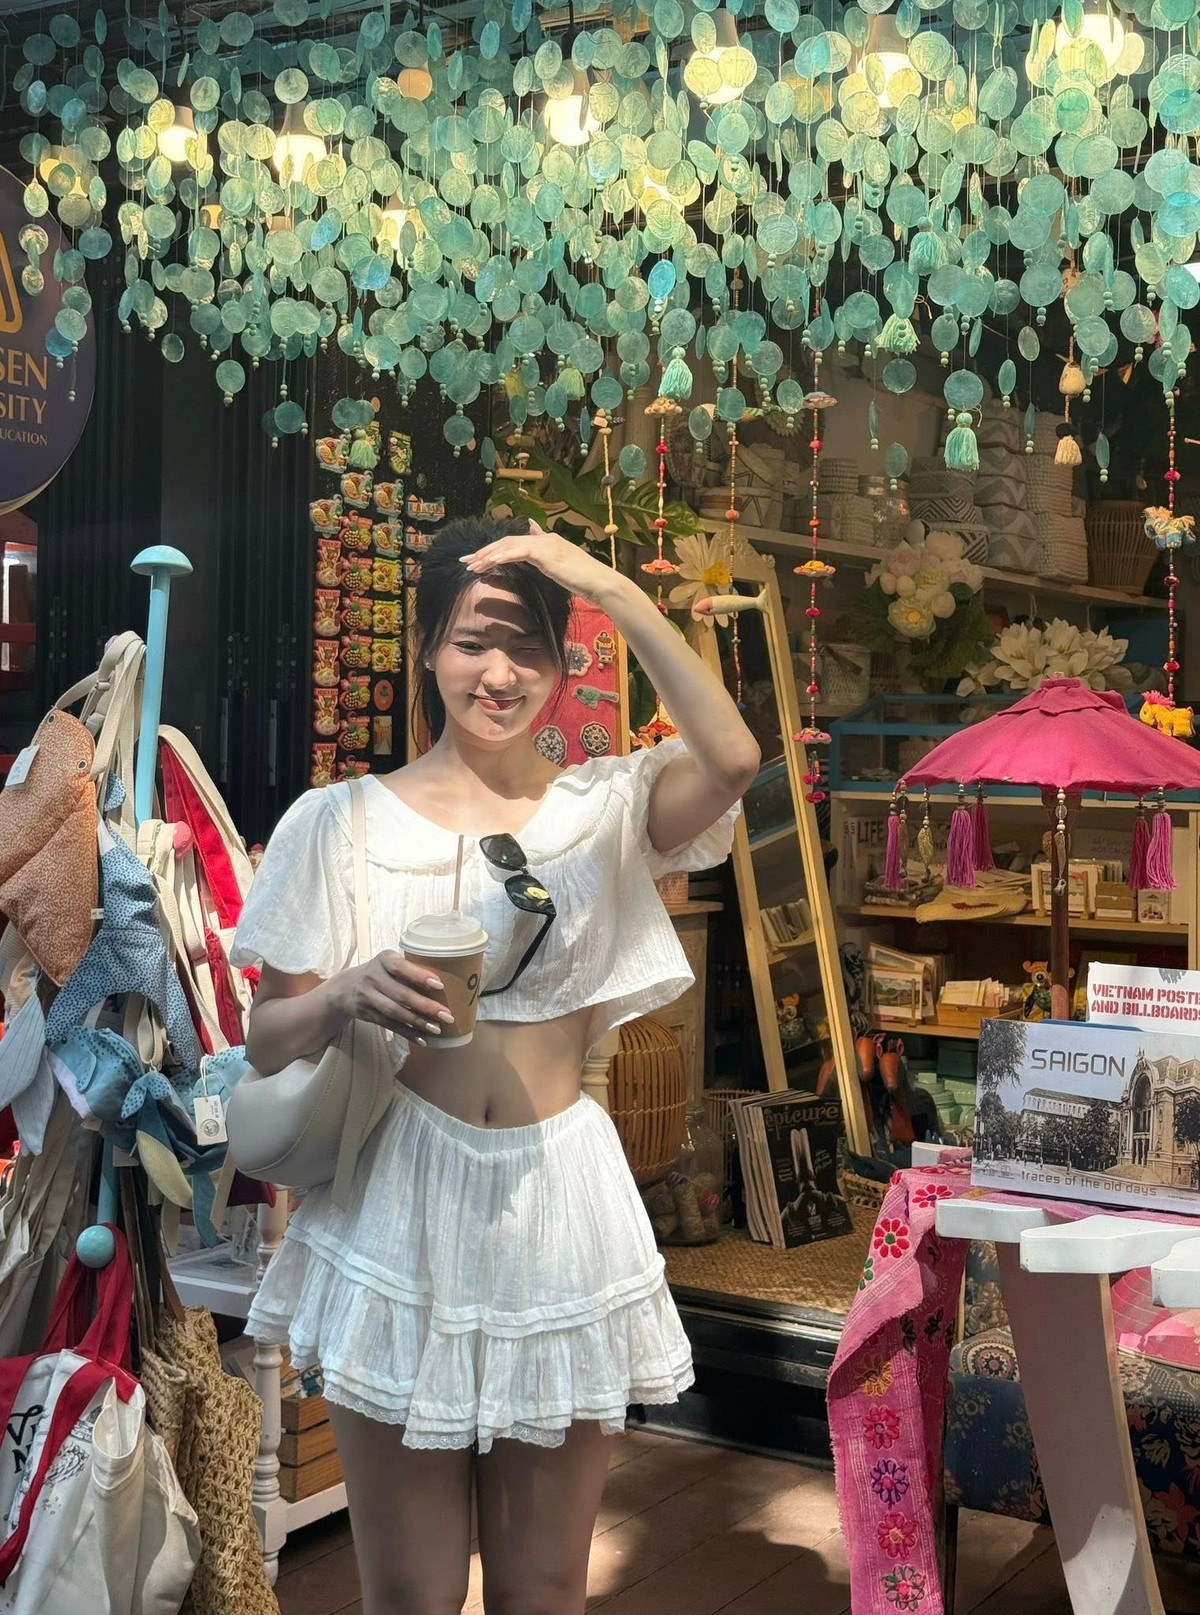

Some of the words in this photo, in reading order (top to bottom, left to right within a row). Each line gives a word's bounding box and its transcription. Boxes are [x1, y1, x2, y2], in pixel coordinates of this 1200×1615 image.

[1092, 983, 1154, 1001] VIETNAM
[1091, 1000, 1119, 1014] AND
[1121, 1001, 1200, 1021] BILLBOARD
[1031, 1048, 1126, 1078] SAIGON
[1021, 1170, 1060, 1184] traces
[1065, 1173, 1077, 1186] of
[1081, 1175, 1100, 1188] the
[1104, 1180, 1122, 1192] old
[1126, 1181, 1157, 1197] days
